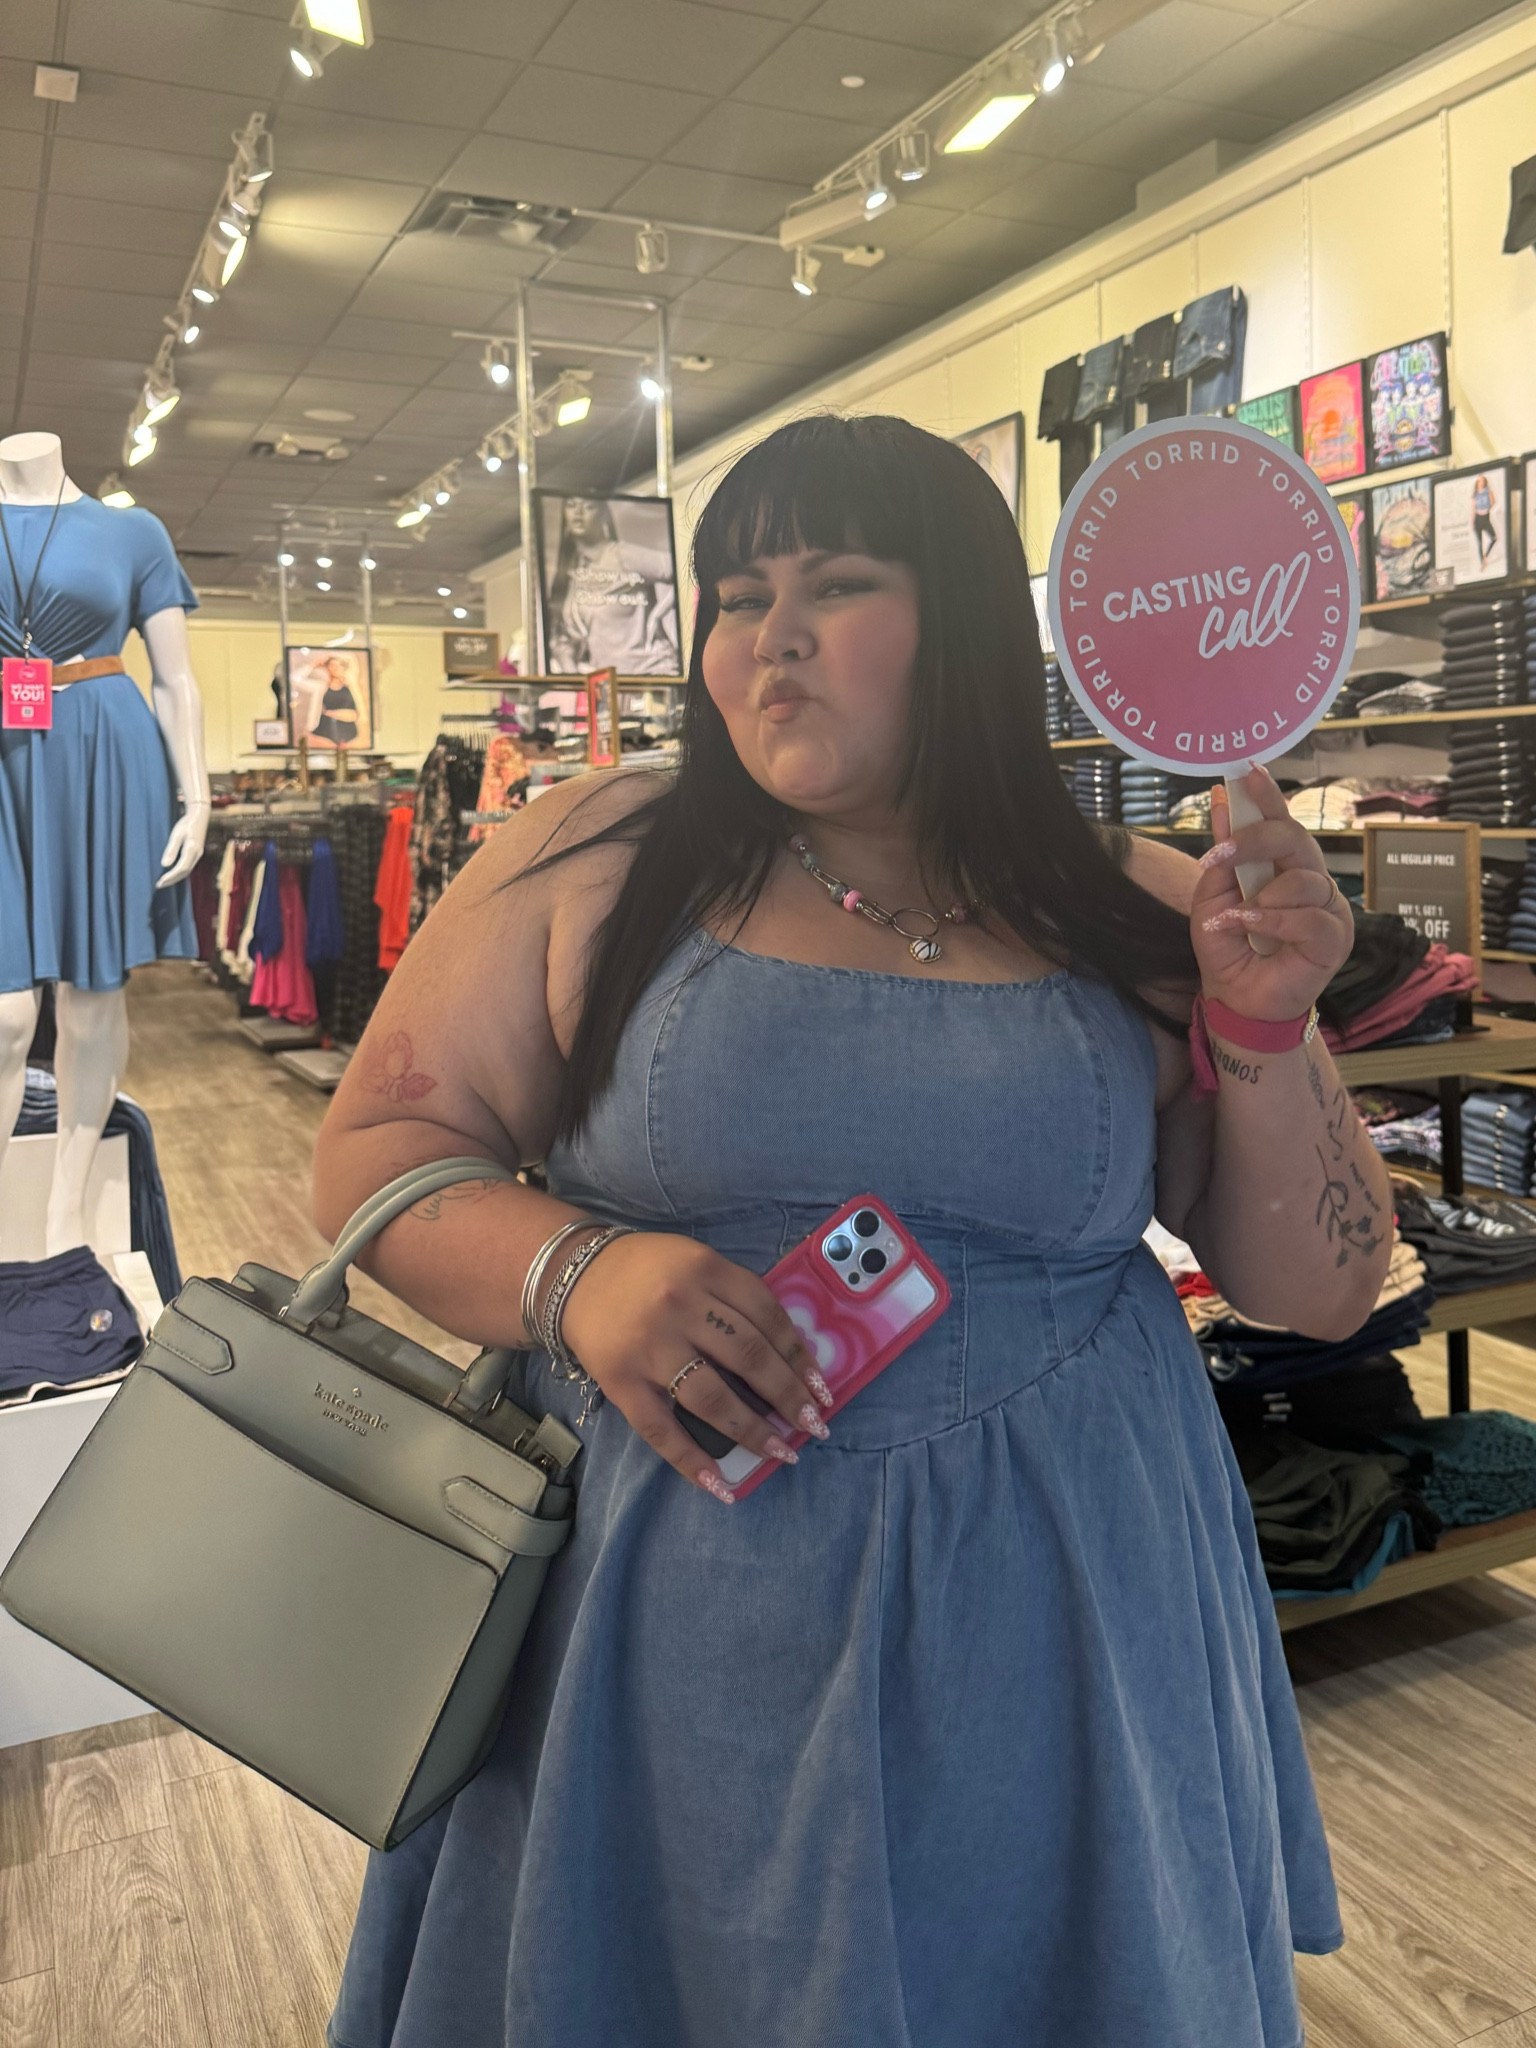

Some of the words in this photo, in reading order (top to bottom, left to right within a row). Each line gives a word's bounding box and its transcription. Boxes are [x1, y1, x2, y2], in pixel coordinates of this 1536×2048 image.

[1125, 441, 1239, 481] TORRID
[1258, 458, 1334, 564] TORRID
[1070, 486, 1118, 612] TORRID
[1103, 565, 1251, 622] CASTING
[1198, 551, 1311, 659] call
[1294, 583, 1341, 703] TORRID
[11, 688, 45, 702] YOU!
[1077, 635, 1157, 741] TORRID
[1175, 709, 1288, 753] TORRID
[1386, 853, 1399, 865] ALL
[1400, 853, 1432, 866] REGULAR
[1434, 854, 1455, 866] PRICE
[1398, 903, 1412, 915] BUY
[1423, 904, 1437, 917] GET
[1424, 919, 1450, 939] OFF
[314, 1381, 345, 1408] kate
[346, 1404, 389, 1432] spade
